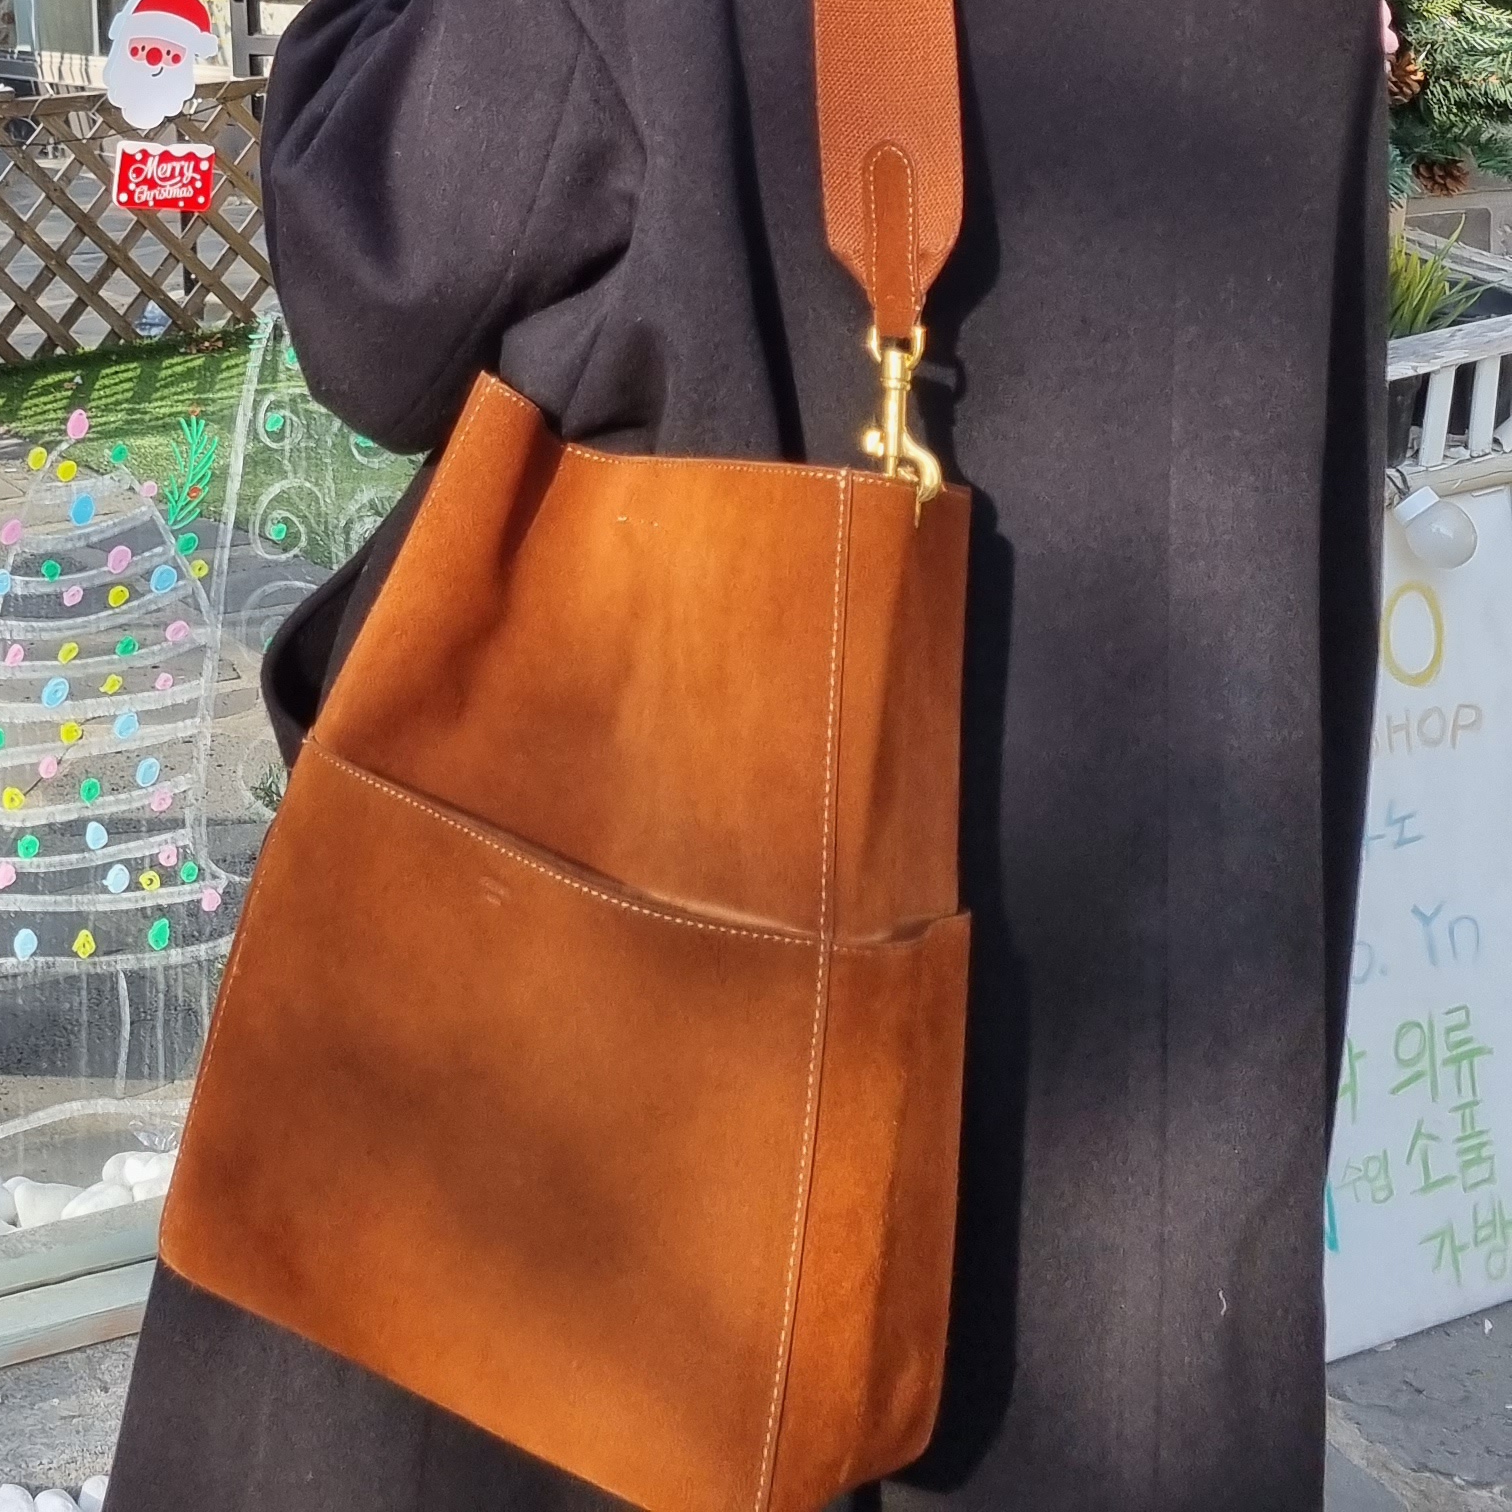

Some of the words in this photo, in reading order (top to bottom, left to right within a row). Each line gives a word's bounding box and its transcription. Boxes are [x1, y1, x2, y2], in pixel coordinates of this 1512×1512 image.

[128, 155, 201, 186] Merry
[133, 182, 194, 204] Christmas
[1372, 702, 1483, 759] HOP
[1389, 1003, 1494, 1104] 의류
[1405, 1098, 1497, 1195] 소품
[1418, 1197, 1512, 1287] 가방
